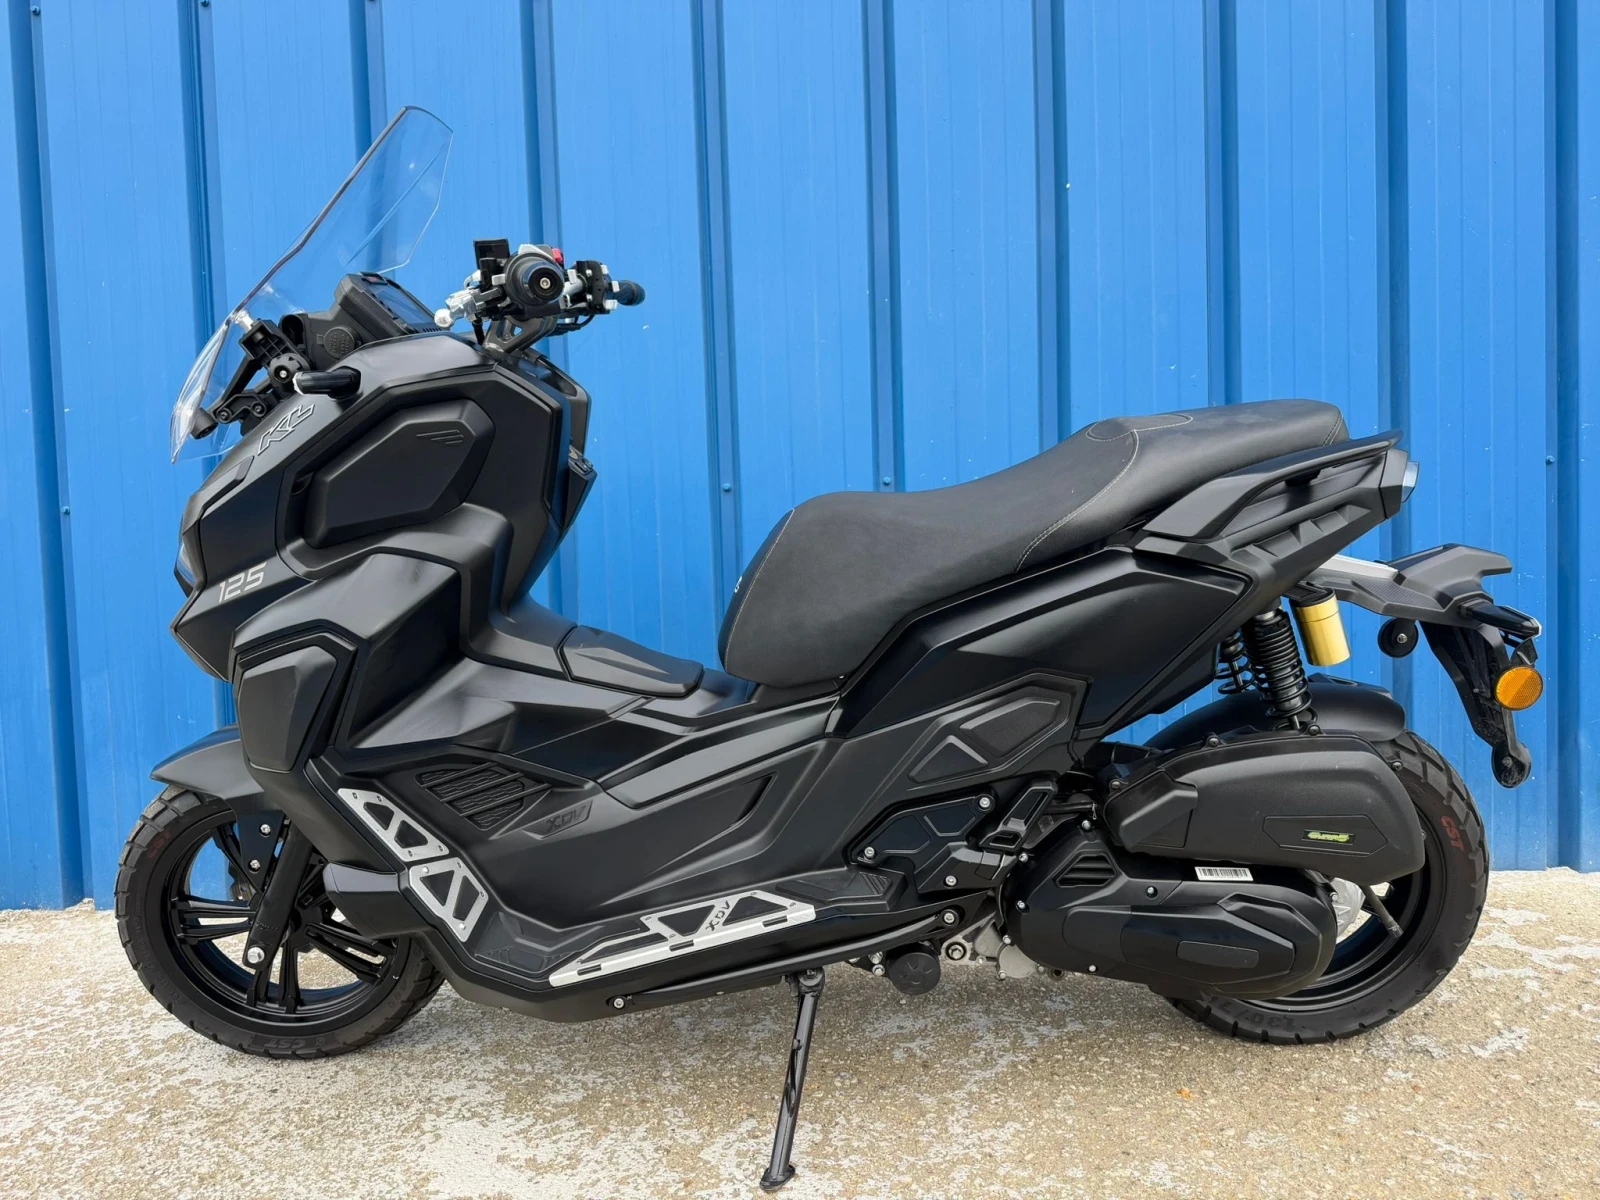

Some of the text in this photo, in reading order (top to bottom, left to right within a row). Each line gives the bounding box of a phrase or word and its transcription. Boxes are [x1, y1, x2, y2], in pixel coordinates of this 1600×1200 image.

[218, 561, 268, 604] 125
[546, 804, 587, 833] XDV
[1441, 815, 1465, 851] CST
[704, 899, 731, 932] XDV
[264, 1037, 307, 1049] CST
